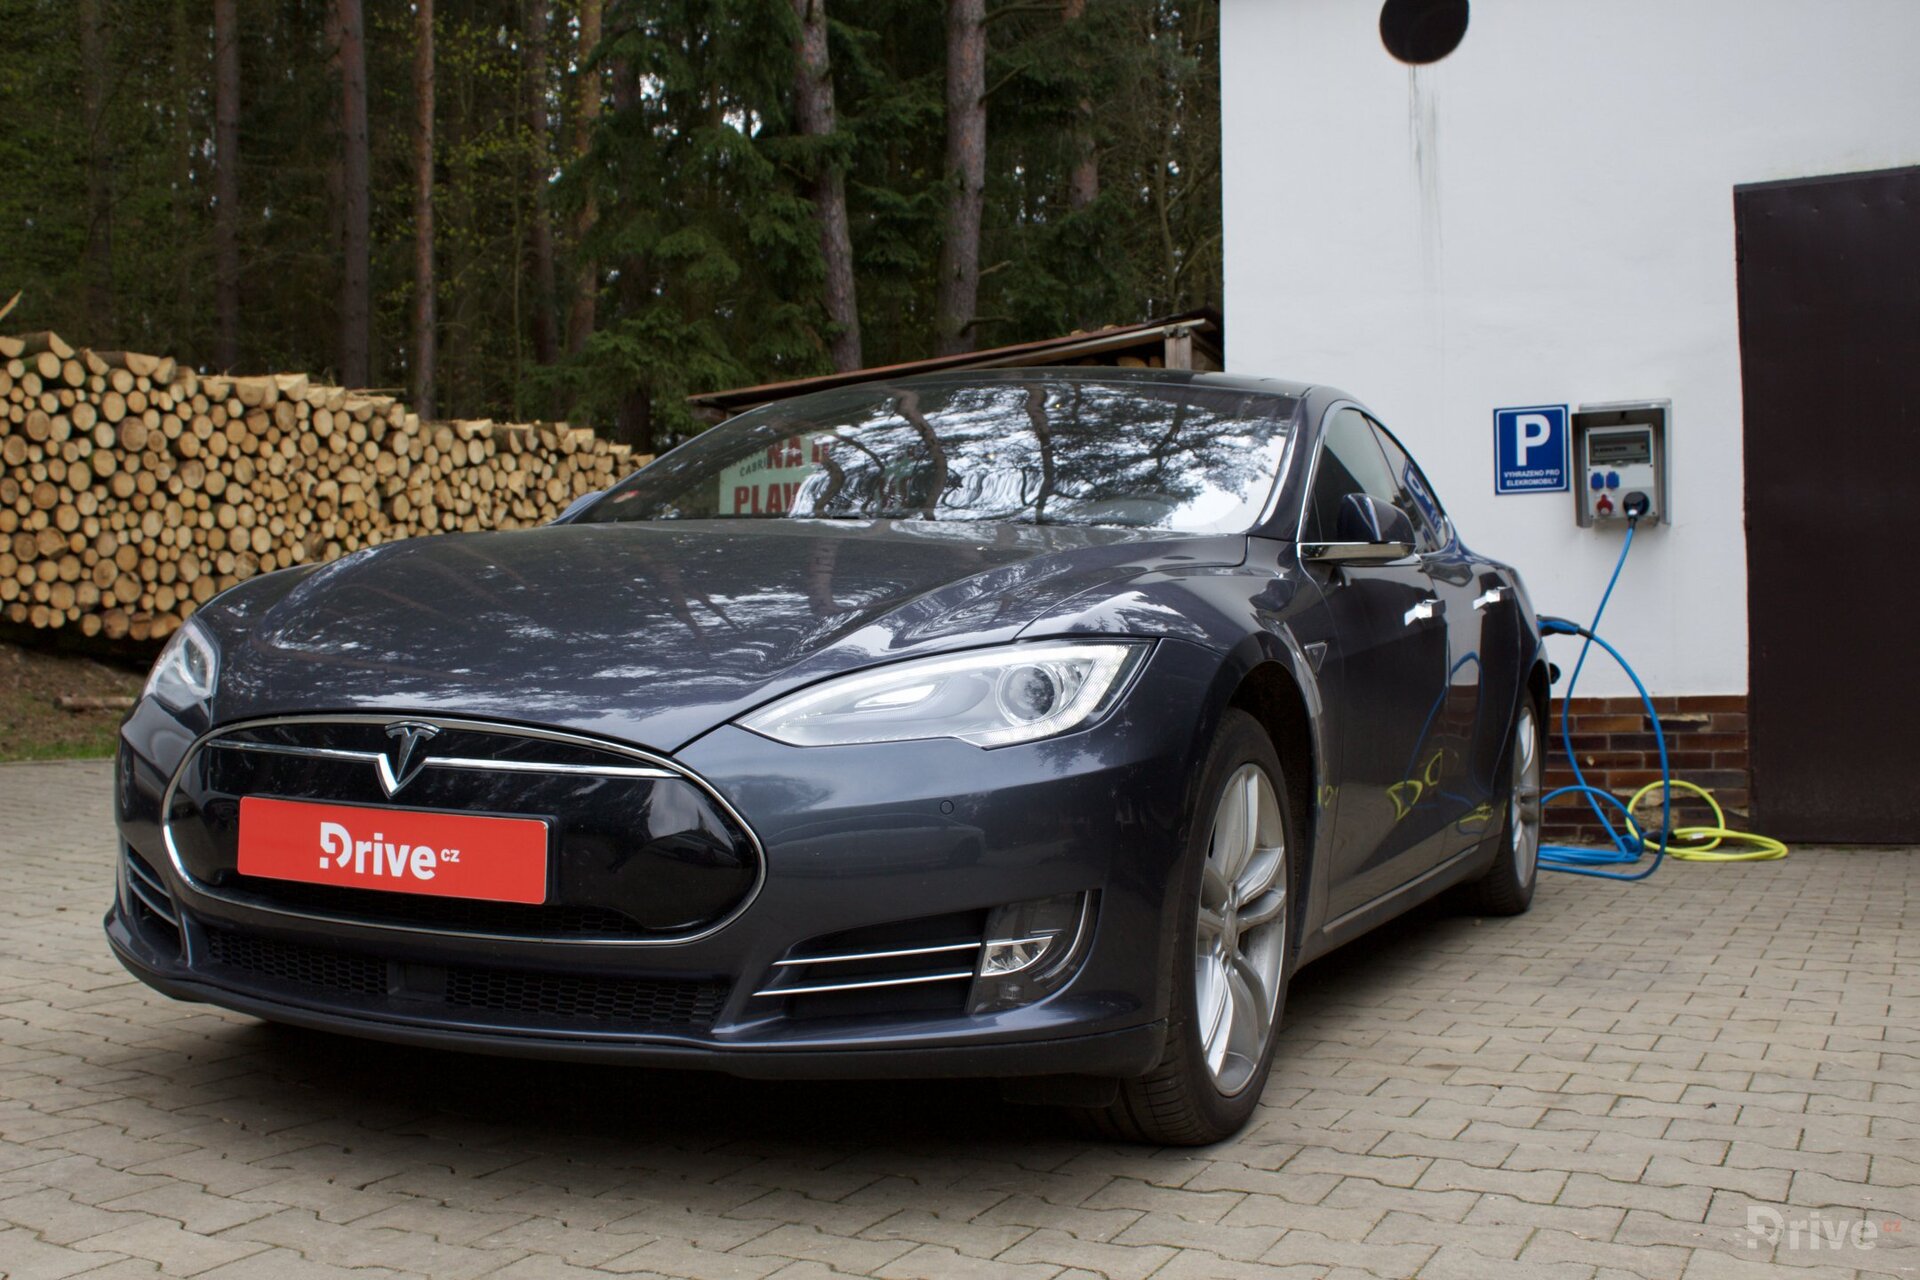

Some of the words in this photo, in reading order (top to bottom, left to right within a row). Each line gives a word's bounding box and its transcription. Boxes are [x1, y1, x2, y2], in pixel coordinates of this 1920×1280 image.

[1516, 413, 1551, 467] P
[1546, 469, 1560, 477] PRO
[319, 821, 437, 881] Drive
